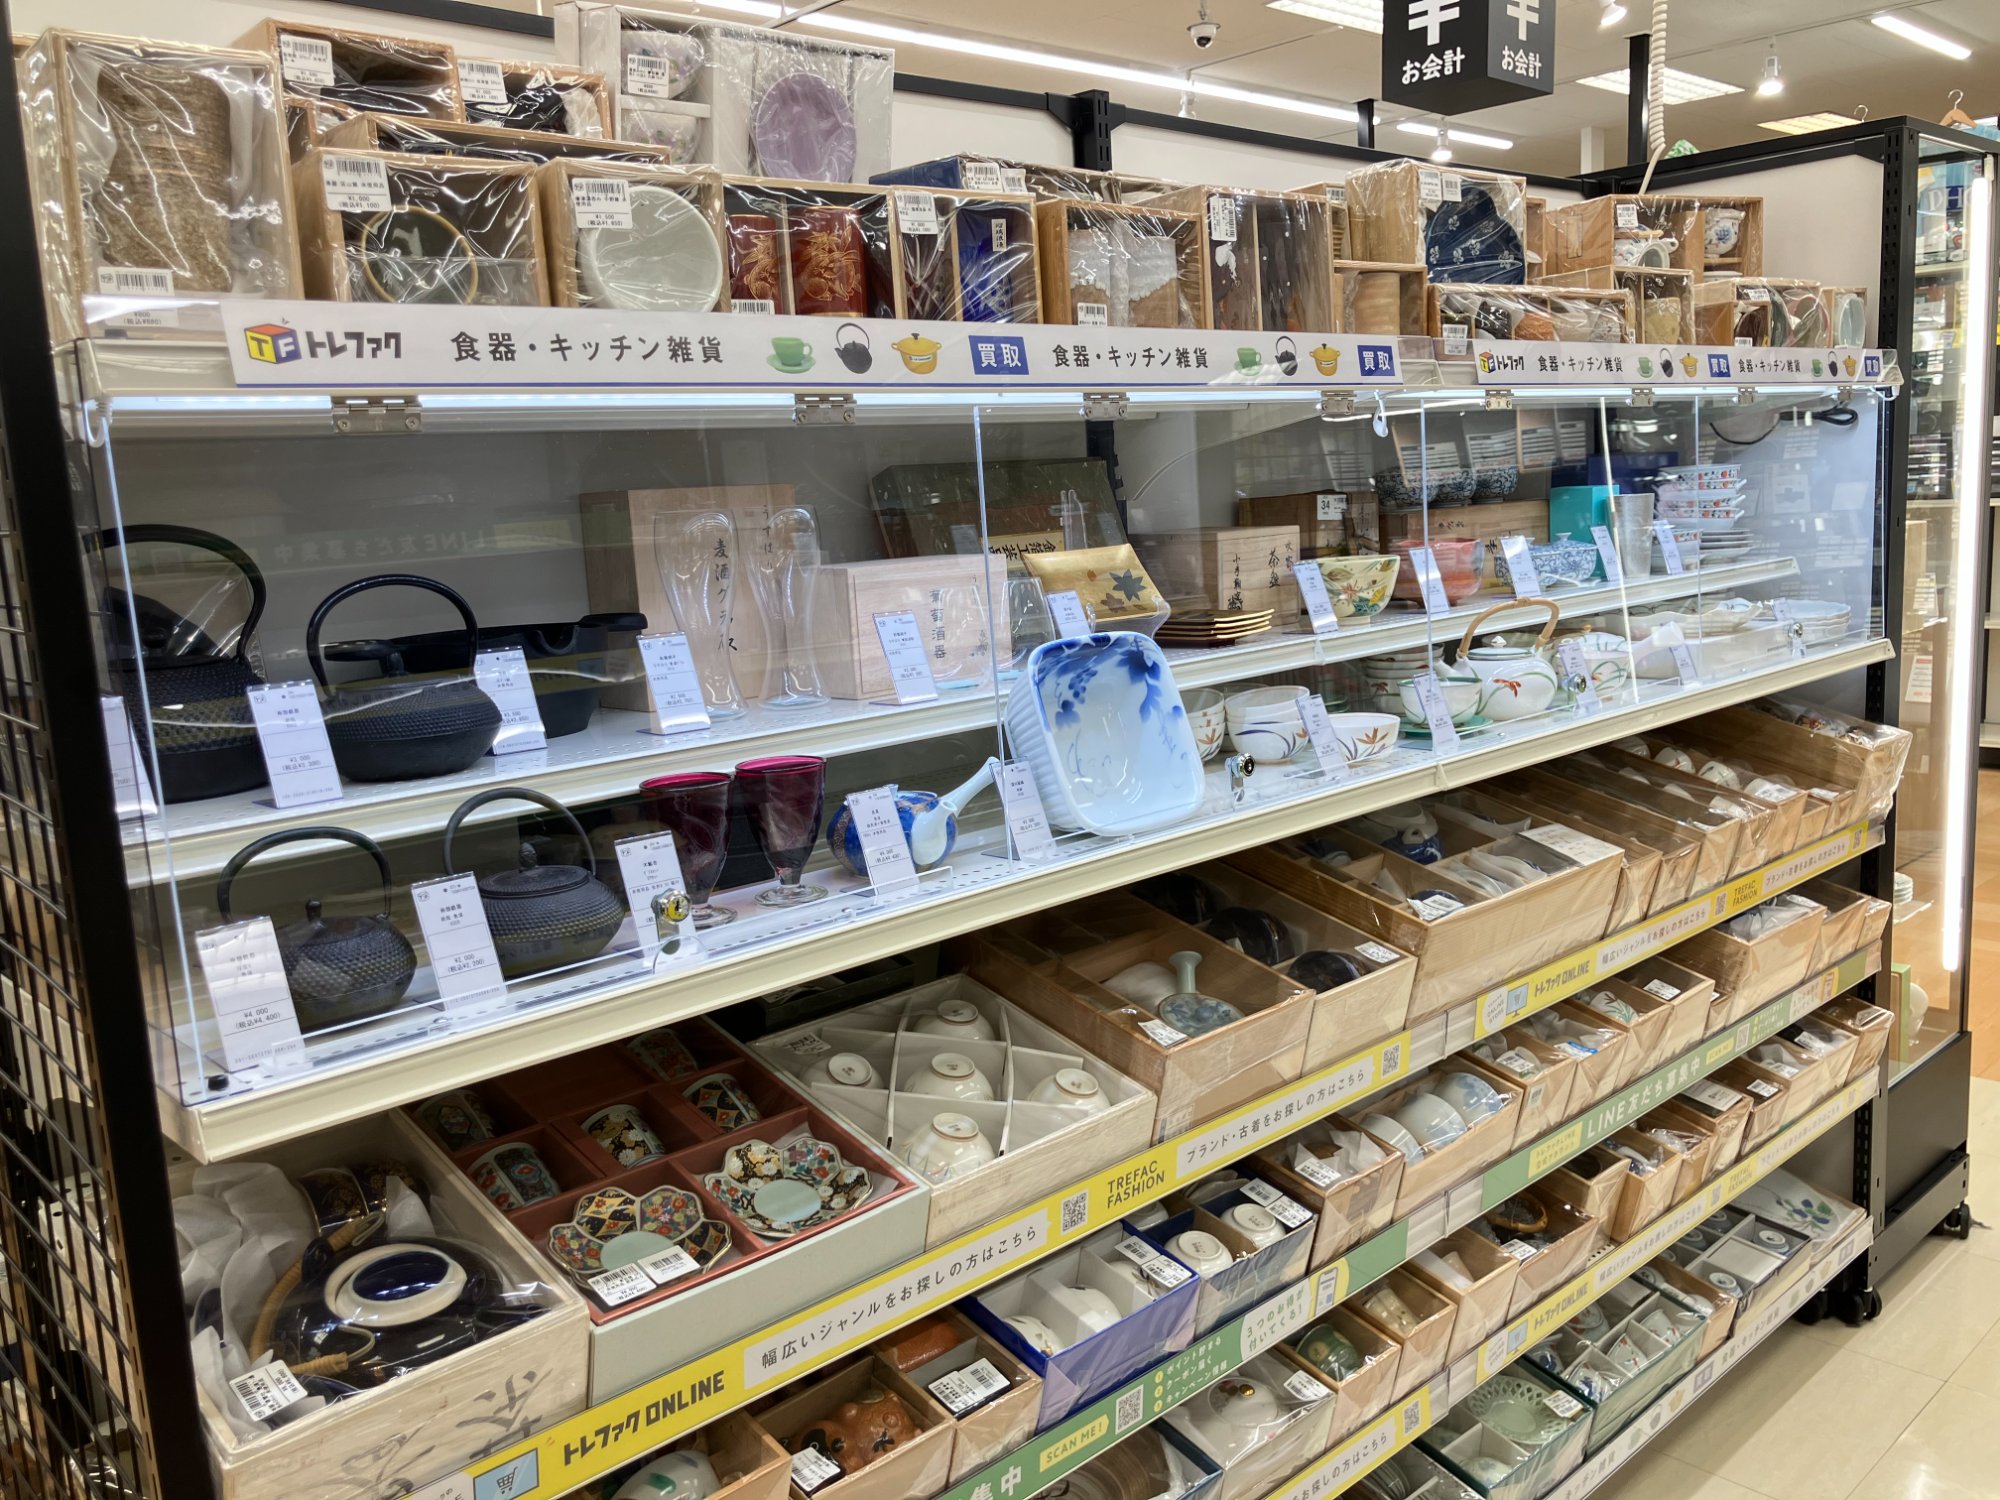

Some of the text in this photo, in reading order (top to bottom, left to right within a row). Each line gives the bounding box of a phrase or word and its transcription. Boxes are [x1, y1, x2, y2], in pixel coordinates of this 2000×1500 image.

[1401, 46, 1465, 85] お会計
[1501, 45, 1542, 80] お会計
[306, 330, 402, 359] トレファク
[451, 330, 724, 364] 食器・キッチン雑貨
[977, 343, 1022, 368] 買取
[1052, 344, 1209, 369] 食器・キッチン雑貨
[1362, 350, 1391, 371] 買取
[1496, 355, 1524, 371] トレファク
[1538, 355, 1623, 372] 食器・キッチン雑貨
[1709, 356, 1730, 374] 買取
[1738, 357, 1801, 373] 食器・キッチン雑貨
[1865, 358, 1881, 374] 買取
[1733, 880, 1756, 895] TREFAC
[1733, 889, 1758, 907] FASHION
[236, 1012, 281, 1030] (税込¥4,400)
[244, 1007, 269, 1018] ¥4,000
[1187, 1068, 1366, 1164] ブランド・古着をお探しの方はこちら
[1107, 1160, 1158, 1193] TREFAC
[1106, 1171, 1165, 1209] FASHION
[761, 1226, 1037, 1369] 幅広いジャンルをお探しの方はこちら
[1046, 1436, 1077, 1464] SCAN
